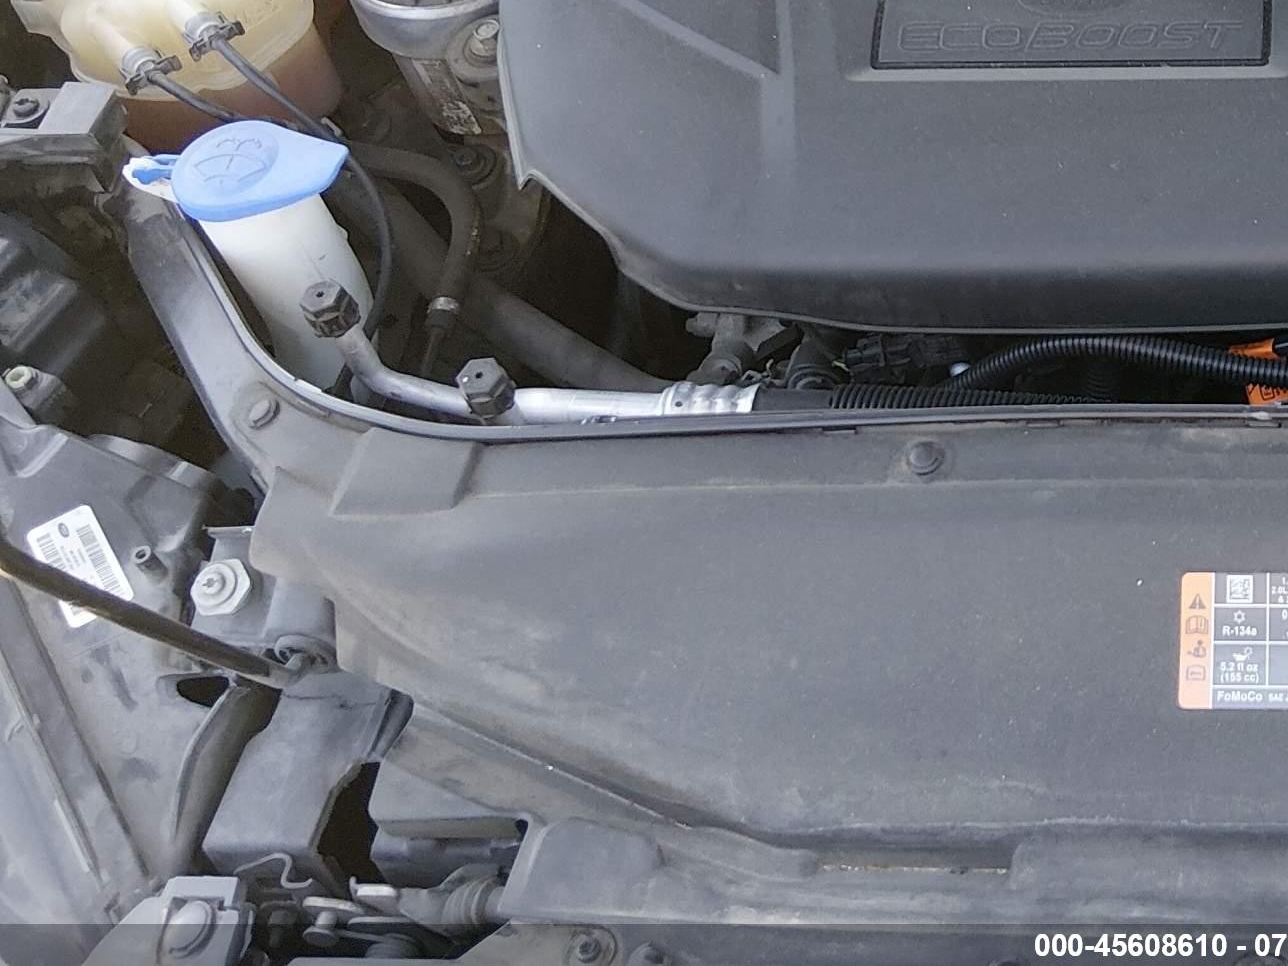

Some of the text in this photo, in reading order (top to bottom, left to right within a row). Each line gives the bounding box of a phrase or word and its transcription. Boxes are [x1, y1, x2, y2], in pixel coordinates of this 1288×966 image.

[899, 20, 1244, 52] ECOBOOST
[1222, 625, 1257, 636] R-134a
[1220, 662, 1258, 672] 5.2 fl oz
[1220, 673, 1259, 683] (155 cc)
[1217, 690, 1263, 701] FoMoCo
